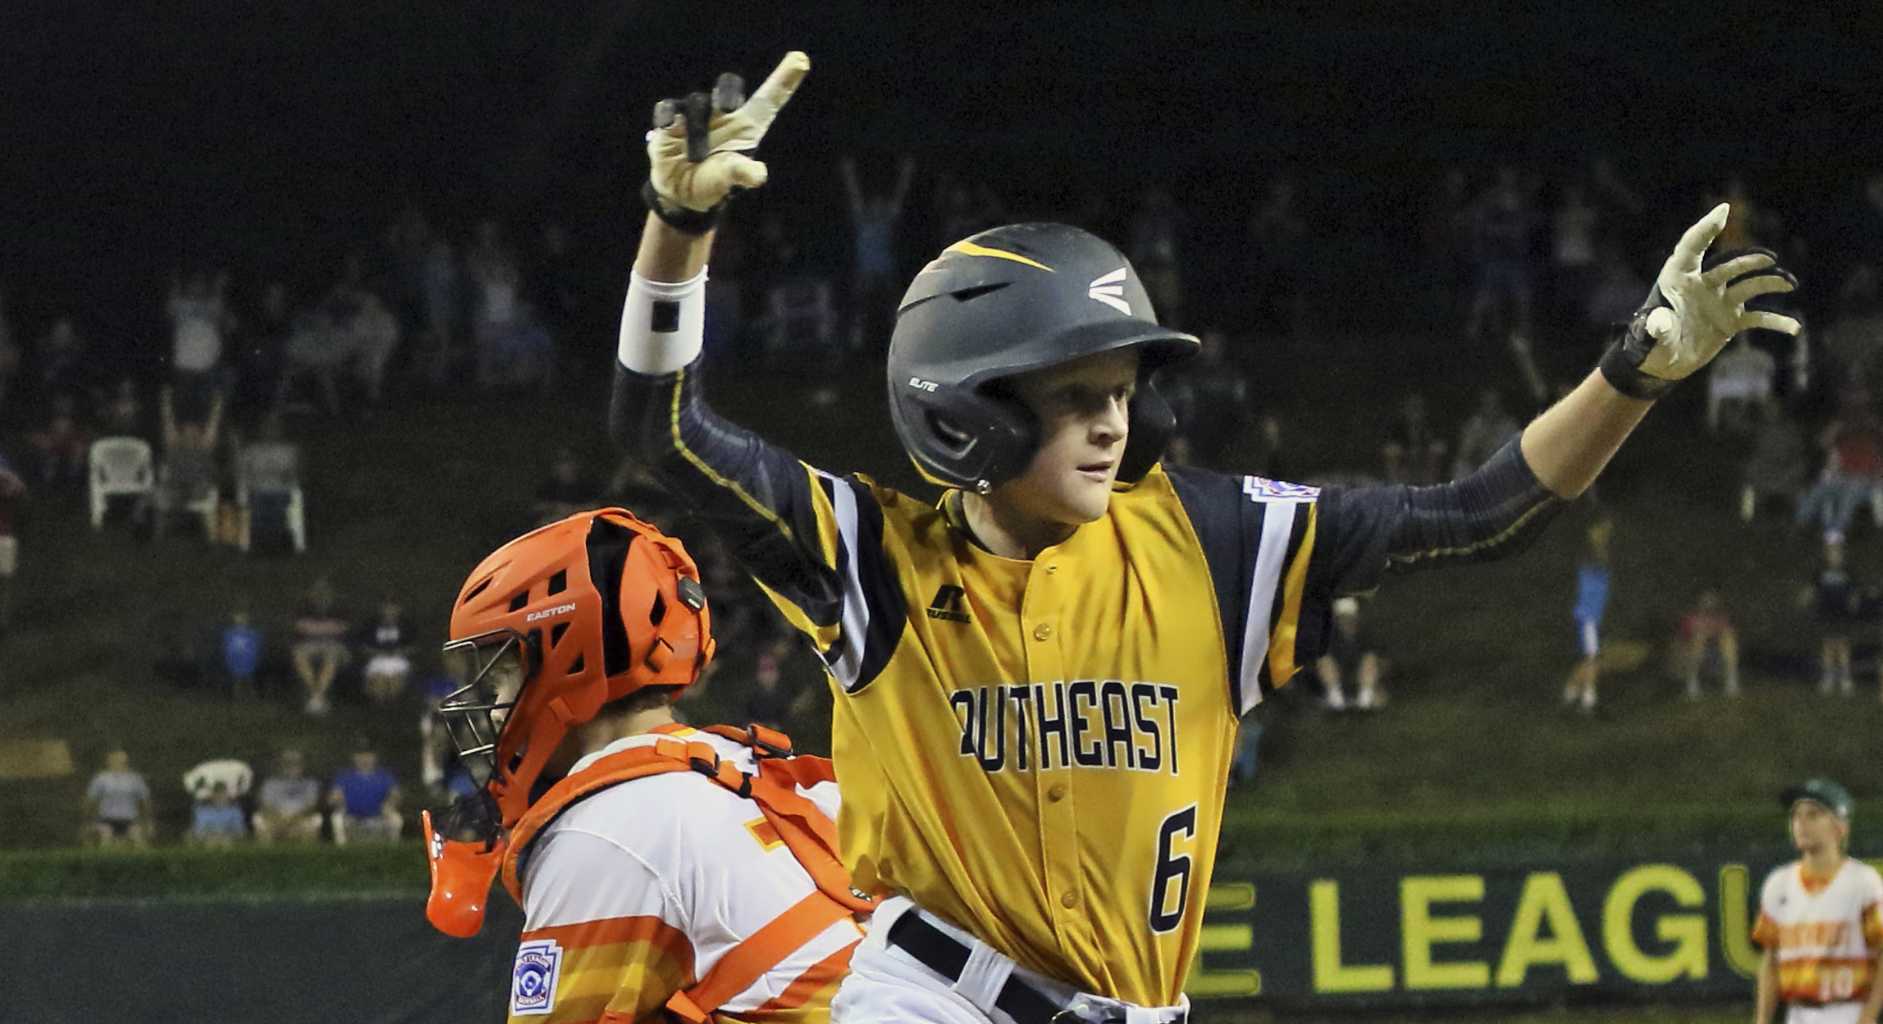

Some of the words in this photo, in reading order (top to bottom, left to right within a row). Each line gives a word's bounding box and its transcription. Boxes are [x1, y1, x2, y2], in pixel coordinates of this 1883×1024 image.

[527, 602, 576, 622] EASTON
[949, 681, 1179, 777] OUTHEAST
[1148, 801, 1198, 936] 6
[1308, 859, 1883, 993] LEAGU
